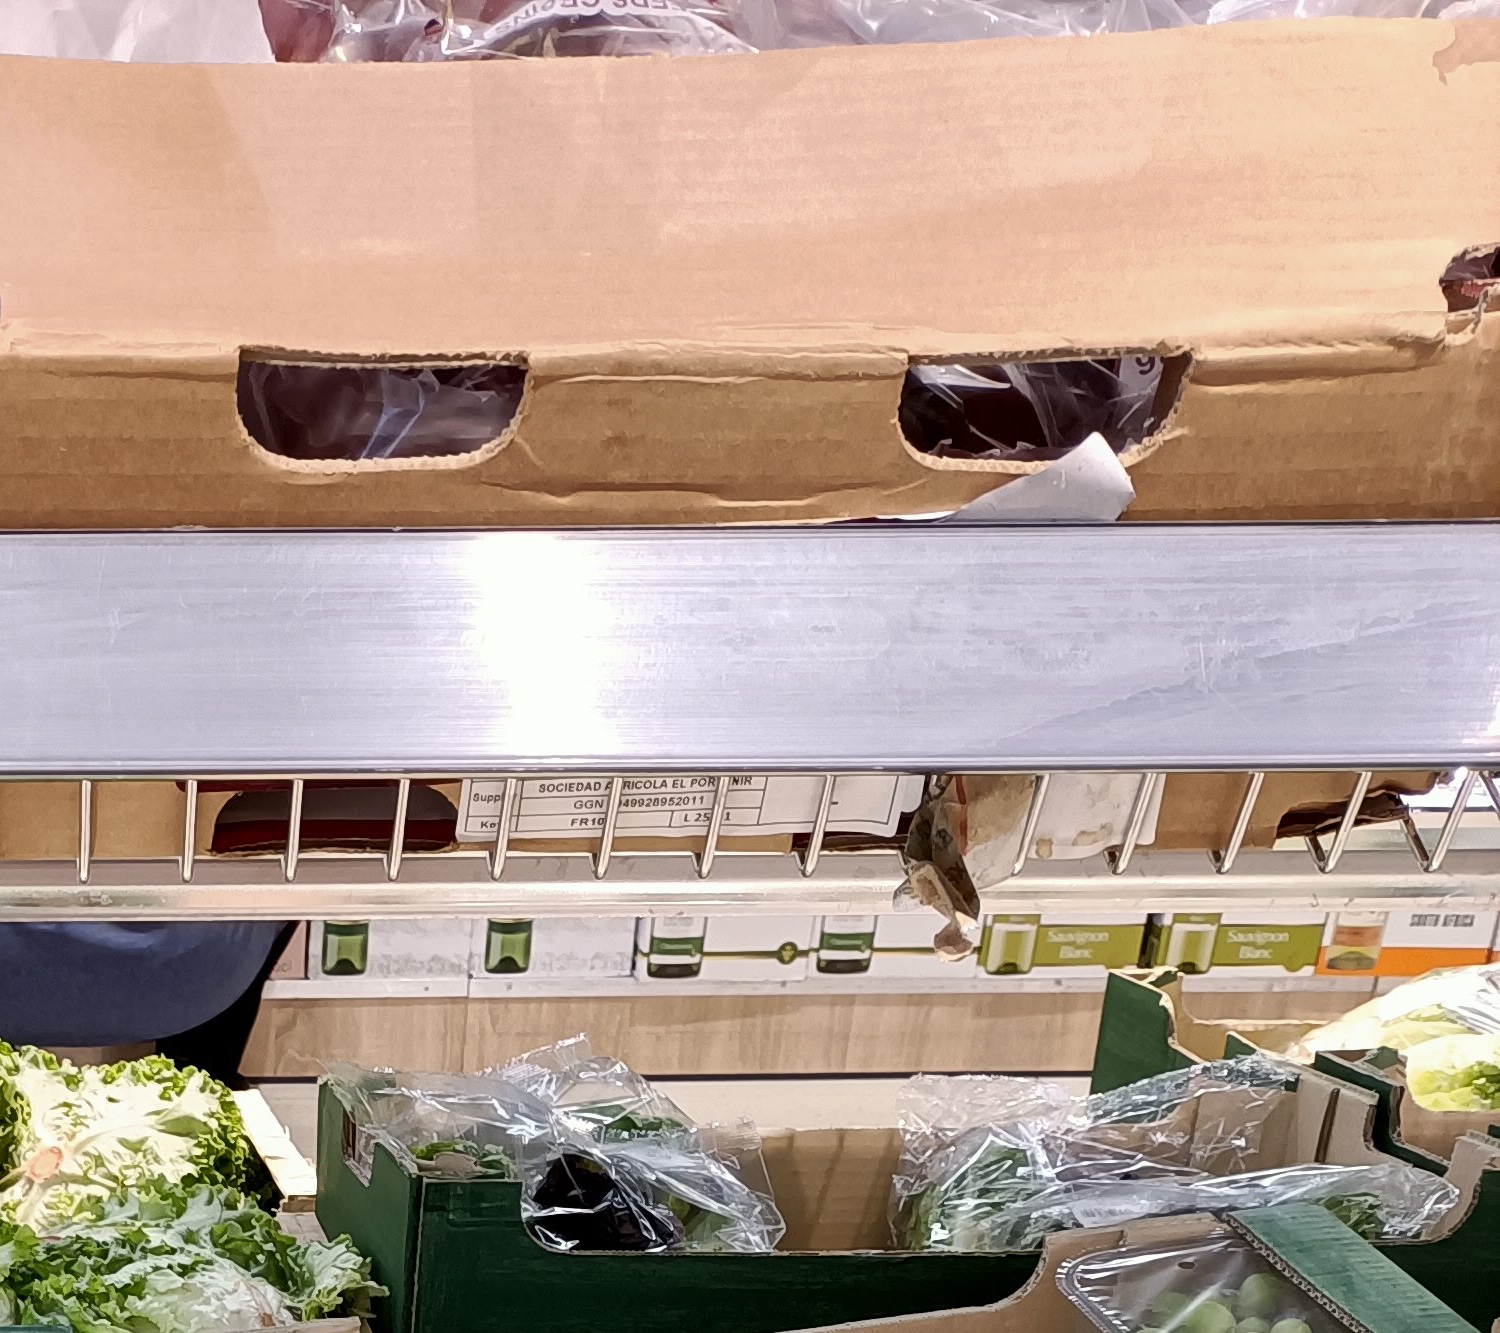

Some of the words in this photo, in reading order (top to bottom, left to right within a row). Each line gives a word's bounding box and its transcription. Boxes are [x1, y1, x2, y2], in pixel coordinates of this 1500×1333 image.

[538, 781, 601, 793] SOCIEDAD
[604, 779, 668, 791] ARICOLA
[671, 779, 687, 789] EL
[573, 799, 604, 810] GGN
[683, 813, 691, 822] L
